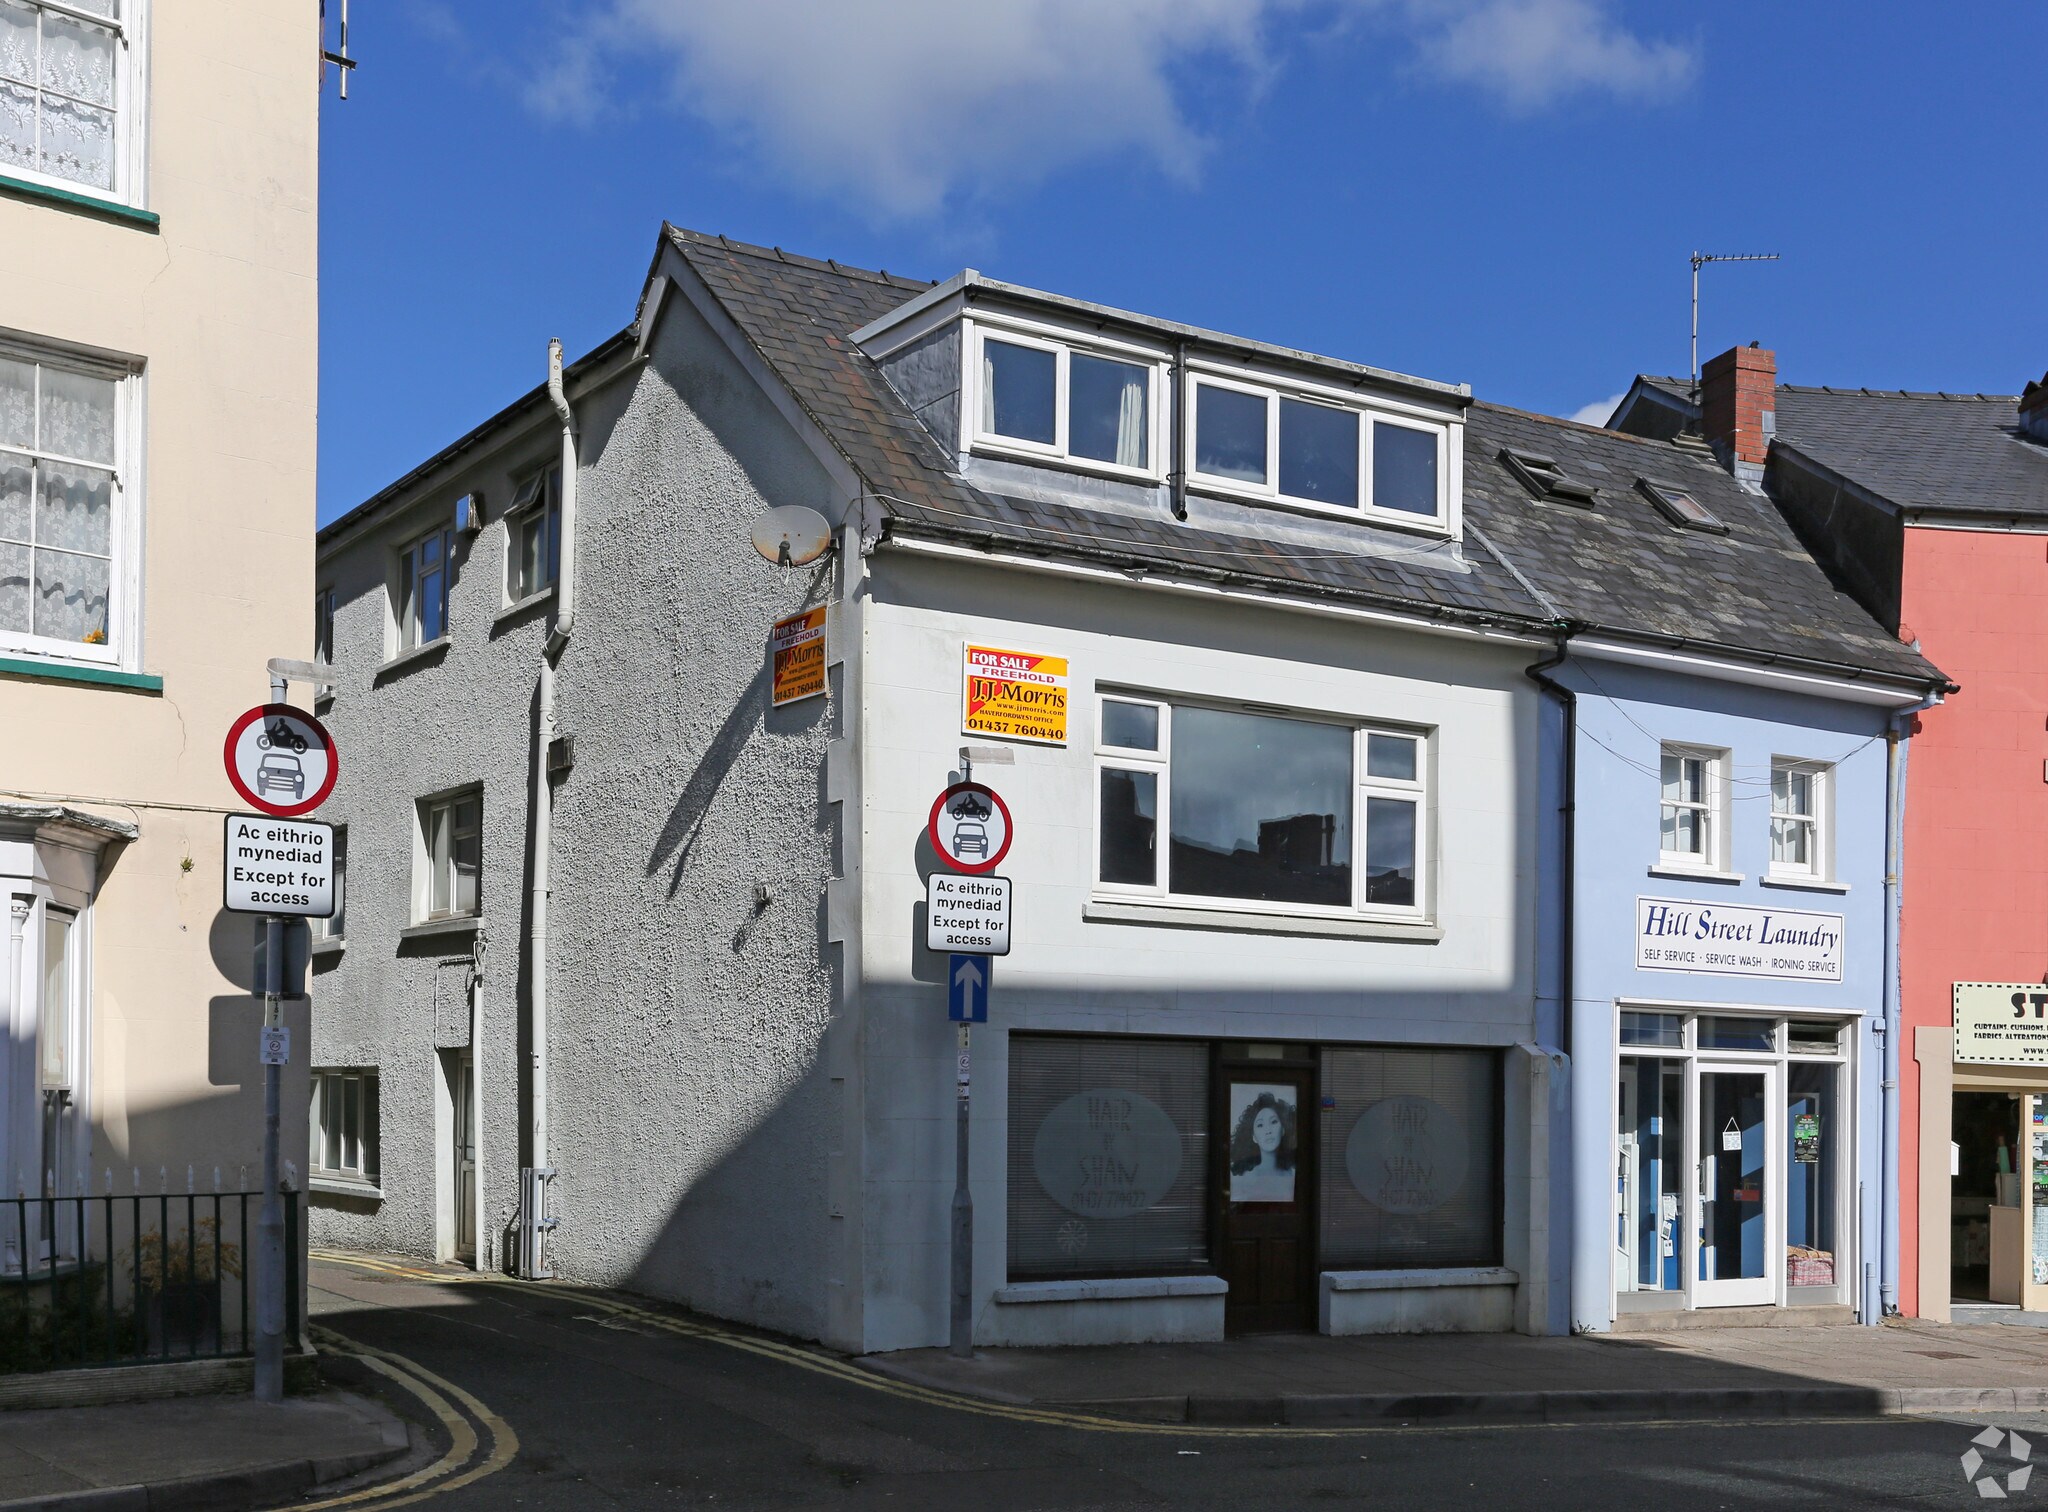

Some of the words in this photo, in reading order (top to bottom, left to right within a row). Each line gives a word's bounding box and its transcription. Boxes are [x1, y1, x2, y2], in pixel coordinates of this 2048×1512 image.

[776, 626, 790, 638] FOR
[790, 620, 806, 634] SALE
[781, 628, 819, 648] FREEHOLD
[791, 638, 824, 666] Morris
[971, 652, 998, 666] FOR
[1000, 656, 1030, 670] SALE
[982, 668, 1055, 684] FREEHOLD
[774, 687, 795, 701] 01437
[973, 679, 997, 702] J.J.
[1001, 683, 1065, 708] Morris
[980, 709, 1032, 721] HAVERFORDWEST
[1033, 716, 1053, 724] OFFICE
[996, 703, 1064, 716] www.jjmorris.com
[968, 718, 1009, 732] 01437
[1014, 724, 1063, 740] 760440
[238, 824, 260, 839] Ac
[267, 828, 323, 845] eithrio
[239, 847, 322, 864] mynediad
[234, 867, 294, 887] Except
[301, 872, 325, 887] for
[936, 880, 954, 892] Ac
[959, 882, 1002, 896] eithrio
[251, 891, 309, 905] access
[937, 899, 1001, 911] mynediad
[934, 915, 980, 930] Except
[985, 918, 1004, 930] for
[1643, 905, 1692, 936] Hill
[1694, 910, 1752, 941] Street
[1758, 915, 1838, 957] Laundry
[946, 934, 992, 946] access
[1644, 948, 1661, 960] SELF
[1664, 950, 1695, 963] SERVICE
[1706, 953, 1736, 966] SERVICE
[1739, 955, 1762, 967] WASH
[1771, 958, 1804, 971] IRONING
[1808, 960, 1836, 973] SERVICE
[1088, 1096, 1132, 1131] HAIR
[1392, 1104, 1428, 1135] HAIR
[1079, 1154, 1139, 1189] SHAN
[1383, 1156, 1434, 1187] SHAN
